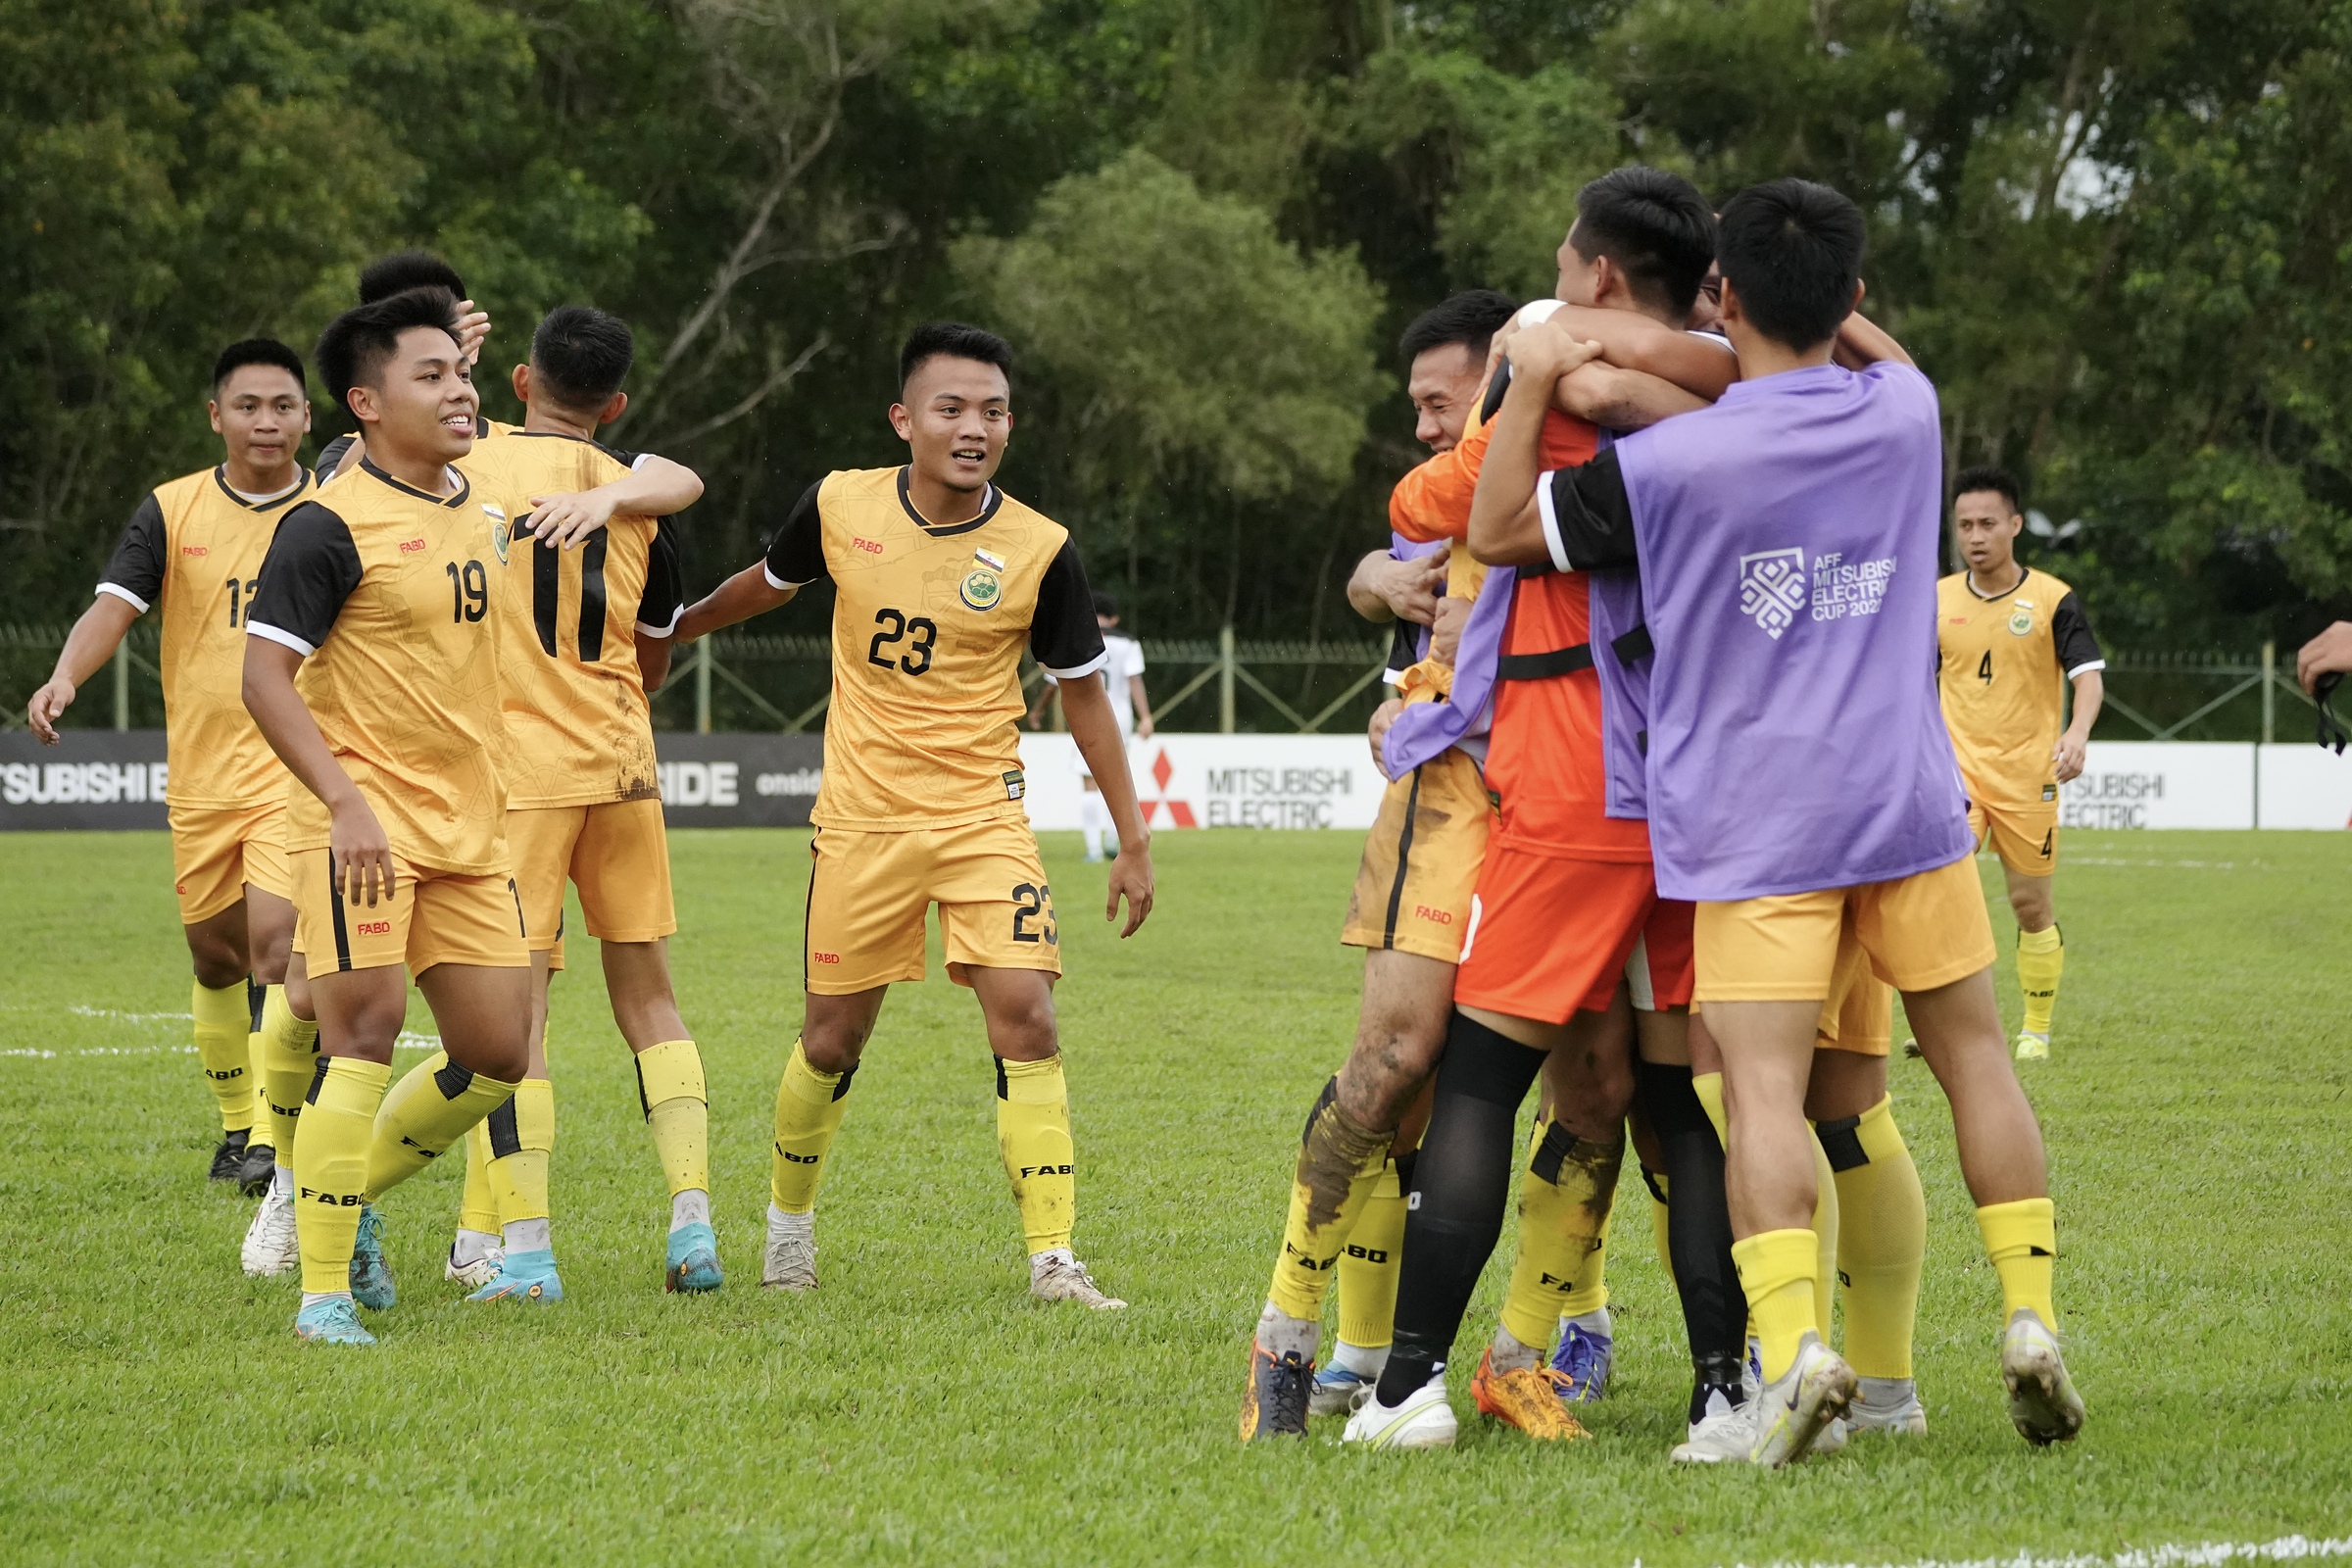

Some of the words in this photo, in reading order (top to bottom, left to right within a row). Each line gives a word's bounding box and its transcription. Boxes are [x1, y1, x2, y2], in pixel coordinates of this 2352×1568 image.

[182, 547, 208, 557] FABD
[399, 538, 426, 554] FABD
[853, 537, 884, 555] FABD
[1814, 553, 1842, 570] AFF
[446, 560, 488, 624] 19
[1811, 604, 1846, 622] CUP
[868, 608, 938, 676] 23
[1978, 649, 1993, 686] 4
[0, 761, 147, 805] SUBISHI
[756, 766, 822, 797] onsid
[1207, 768, 1352, 796] MITSUBISHI
[1207, 801, 1334, 829] ELECTRIC
[2063, 804, 2146, 829] ECTRIC
[2040, 827, 2053, 861] 4
[1012, 882, 1058, 946] 23
[1415, 905, 1453, 925] FABD
[357, 921, 391, 936] FABD
[813, 952, 840, 964] FABD
[205, 1066, 244, 1081] ABD
[775, 1141, 819, 1164] ABD
[1020, 1164, 1075, 1179] FAB
[1342, 1243, 1389, 1264] BD
[1540, 1271, 1574, 1293] FA
